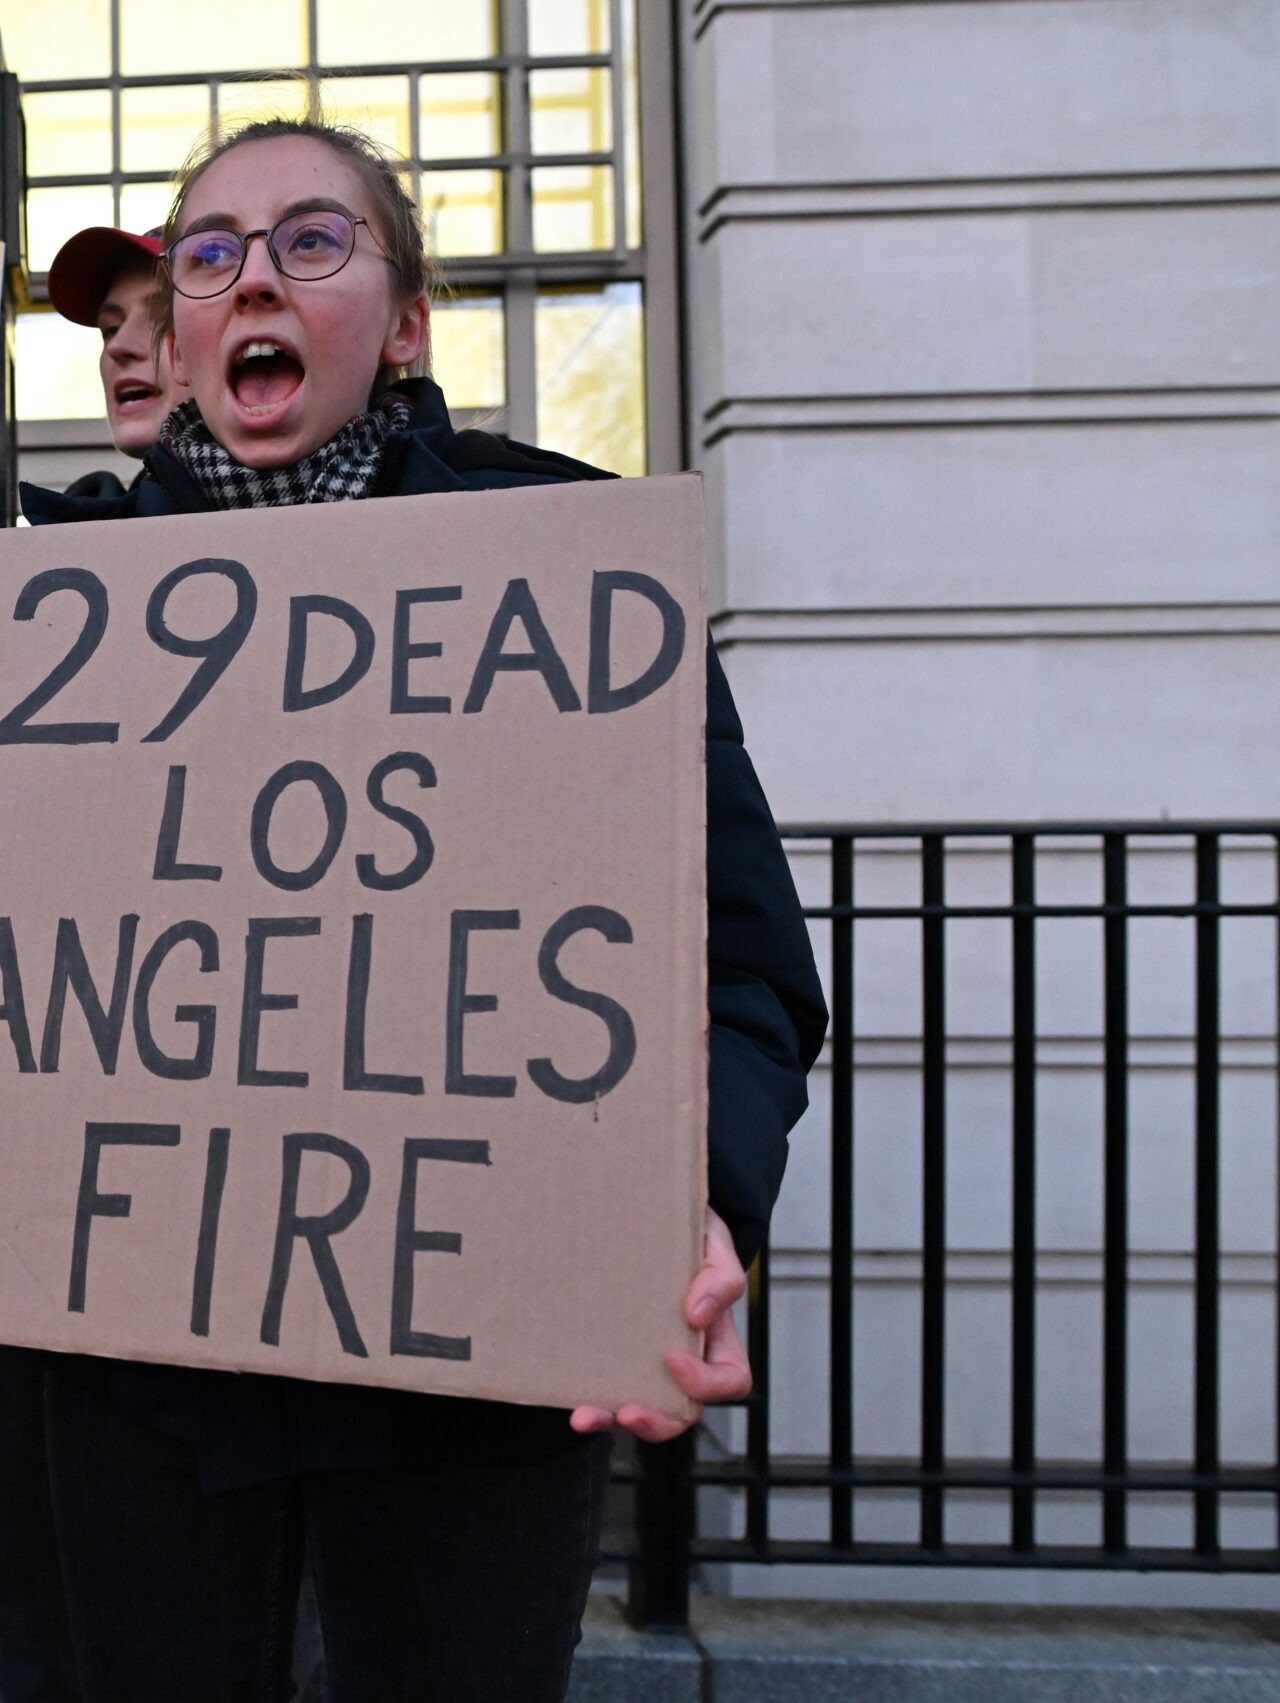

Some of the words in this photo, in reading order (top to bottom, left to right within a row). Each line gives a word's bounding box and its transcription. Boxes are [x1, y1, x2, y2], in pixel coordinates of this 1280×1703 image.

[283, 570, 687, 715] DEAD
[152, 751, 438, 892] LOS
[67, 1121, 493, 1361] FIRE
